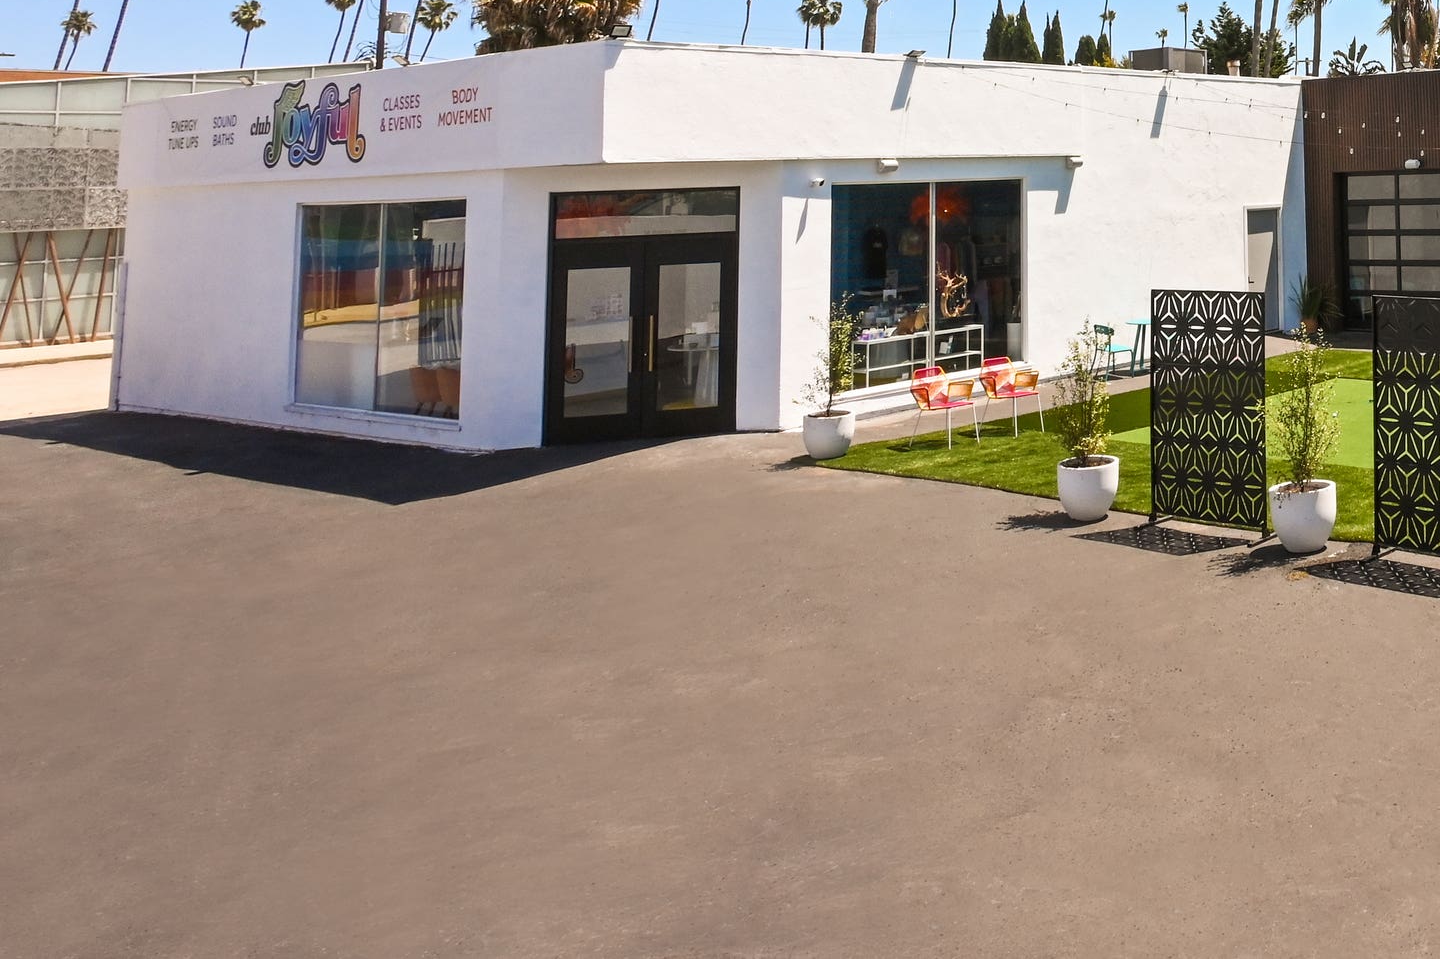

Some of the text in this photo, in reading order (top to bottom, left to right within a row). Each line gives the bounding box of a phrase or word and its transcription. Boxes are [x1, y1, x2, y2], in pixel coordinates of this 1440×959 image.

[383, 94, 420, 112] CLASSES
[452, 87, 479, 104] BODY
[213, 114, 237, 129] SOUND
[250, 79, 366, 168] club Joyful
[380, 114, 422, 132] & EVENTS
[438, 107, 493, 127] MOVEMENT
[171, 119, 198, 133] ENERGY
[168, 136, 199, 150] TUNE UPS
[212, 132, 235, 146] BATHS
